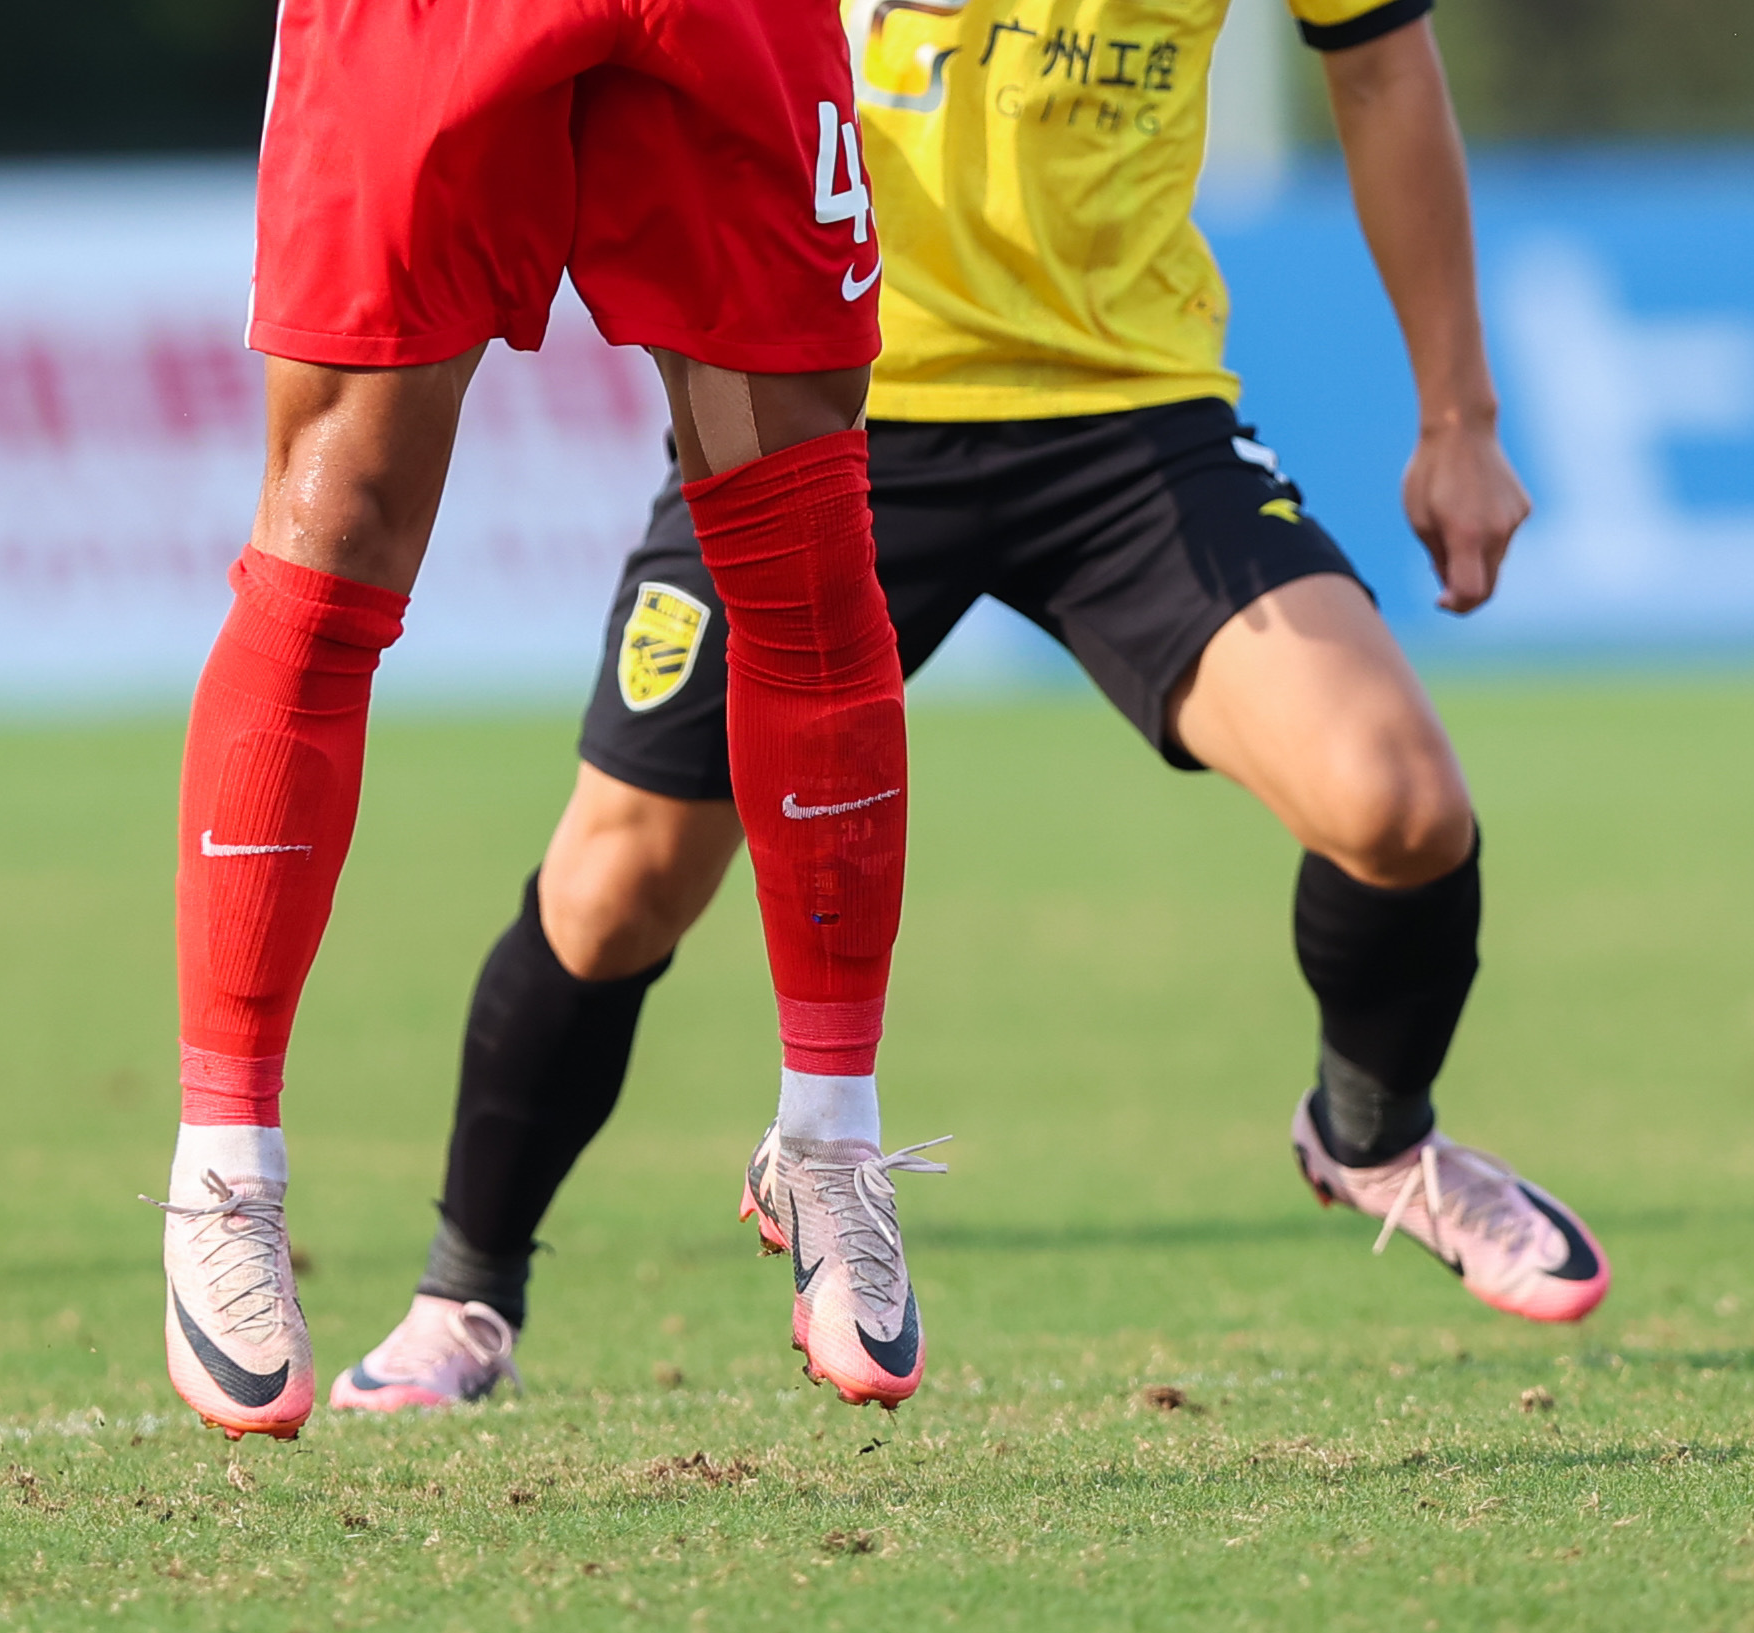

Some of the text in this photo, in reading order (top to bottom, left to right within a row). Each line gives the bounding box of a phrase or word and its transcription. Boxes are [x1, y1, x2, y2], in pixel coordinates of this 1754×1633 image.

[979, 18, 1178, 92] 广州工控
[814, 100, 870, 245] 4
